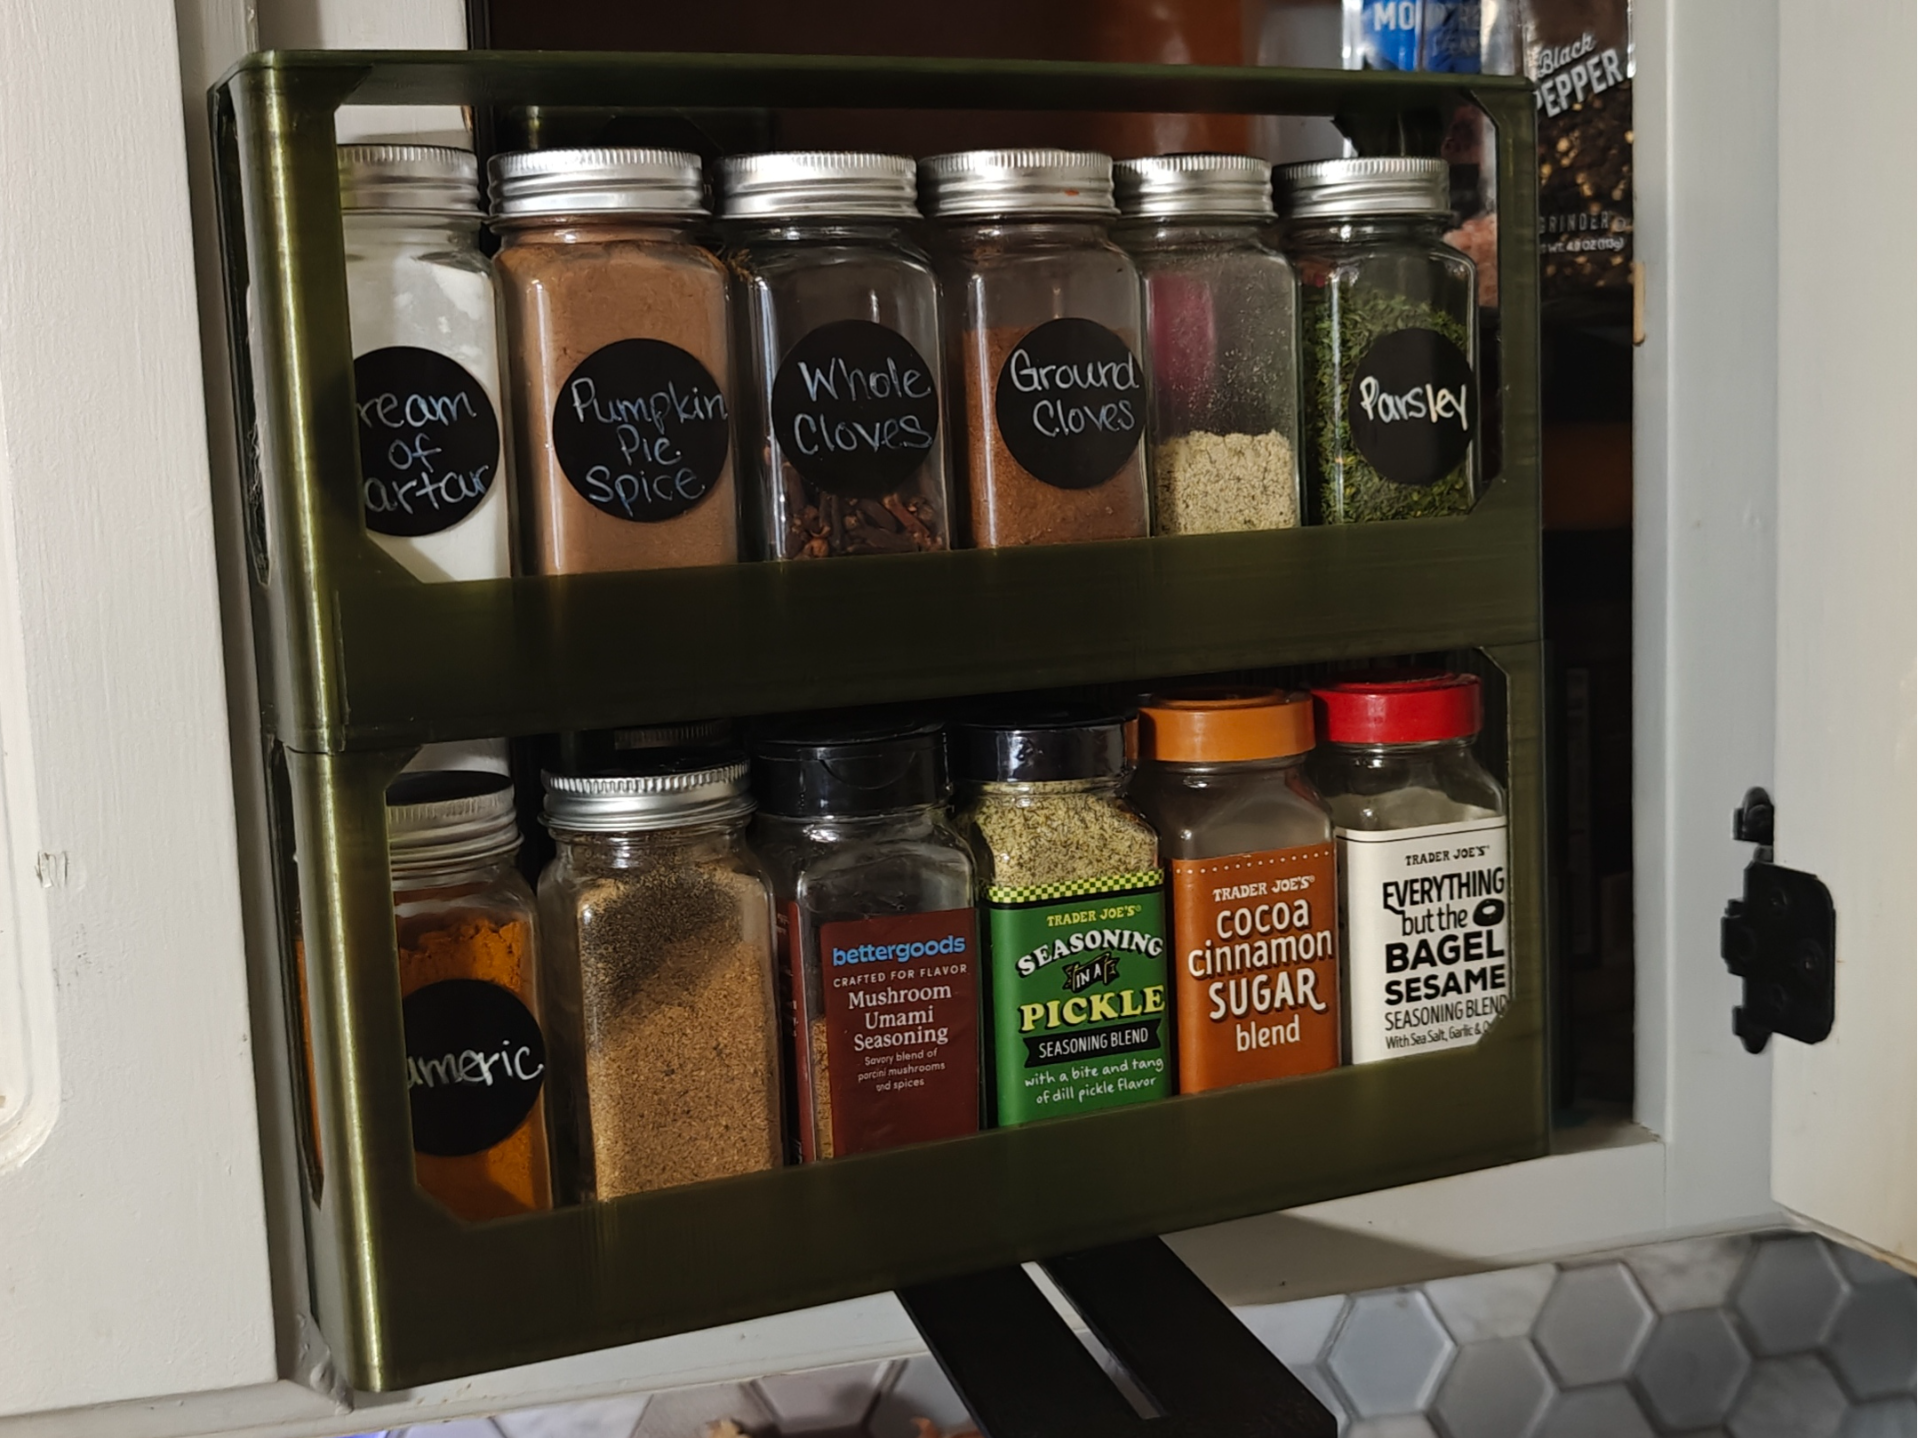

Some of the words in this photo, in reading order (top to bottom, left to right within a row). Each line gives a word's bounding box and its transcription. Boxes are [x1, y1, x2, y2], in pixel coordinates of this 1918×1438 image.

[1538, 32, 1596, 77] Black
[798, 357, 932, 401] Whole
[1010, 349, 1140, 392] Ground
[355, 391, 476, 428] ream
[571, 377, 728, 433] Pumpkin
[1033, 399, 1135, 437] Cloves
[1360, 376, 1468, 431] Parsley
[388, 433, 442, 472] of
[617, 424, 682, 465] Pie
[793, 413, 932, 454] Cloves
[364, 464, 489, 513] artar
[585, 465, 705, 517] Spice
[1405, 850, 1450, 866] TRADER
[1453, 846, 1486, 860] JOE'S
[1213, 882, 1268, 902] TRADER
[1271, 876, 1311, 893] JOE'S
[1382, 867, 1505, 915] EVERYTHING
[1047, 910, 1097, 927] TRADER
[1100, 905, 1136, 920] JOE'S
[1401, 908, 1434, 936] but
[1438, 904, 1468, 930] the
[833, 935, 966, 966] bettergoods
[1016, 929, 1164, 976] SEASONING
[1188, 930, 1332, 977] cinnamon
[1385, 929, 1505, 974] BAGEL
[833, 972, 886, 988] CRAFTED
[890, 969, 915, 980] FOR
[920, 964, 967, 978] FLAVOR
[1076, 970, 1090, 989] IN
[1094, 963, 1102, 979] A
[1209, 968, 1327, 1020] SUGAR
[1385, 964, 1506, 1006] SESAME
[848, 985, 952, 1009] Mushroom
[1020, 985, 1166, 1032] PICKLE
[1385, 1000, 1463, 1031] SEASONING
[1466, 994, 1508, 1018] BLEND
[865, 1005, 934, 1030] Umami
[1236, 1014, 1300, 1052] blend
[1385, 1035, 1410, 1049] With
[1411, 1032, 1426, 1046] Sea
[1449, 1024, 1474, 1040] Garlic
[854, 1026, 949, 1052] Seasoning
[865, 1055, 894, 1067] Savory
[896, 1049, 924, 1062] blend
[926, 1047, 938, 1058] of
[1039, 1033, 1108, 1058] SEASONING
[1110, 1027, 1148, 1048] BLEND
[407, 1040, 545, 1089] umeric
[888, 1061, 946, 1076] mushrooms
[1024, 1069, 1056, 1088] with
[1059, 1072, 1068, 1082] a
[1072, 1064, 1098, 1080] bite
[1102, 1059, 1128, 1075] and
[1132, 1057, 1164, 1072] tang
[893, 1078, 925, 1091] spices
[1036, 1090, 1050, 1104] of
[1052, 1086, 1074, 1102] dill
[1078, 1081, 1114, 1103] pickle
[1118, 1076, 1157, 1092] flavor
